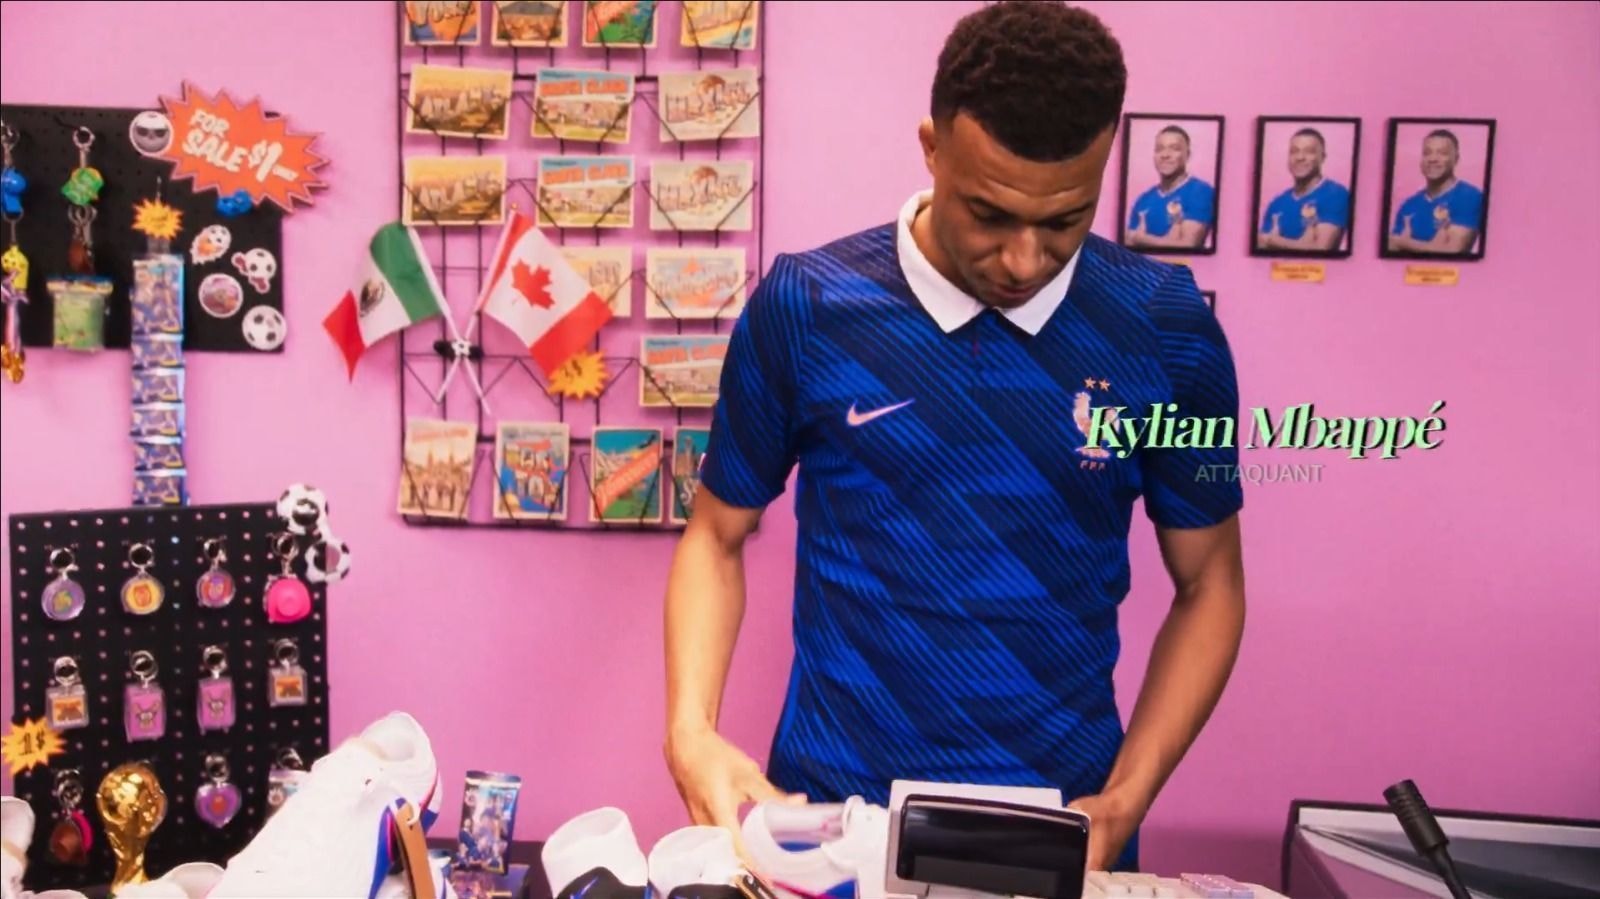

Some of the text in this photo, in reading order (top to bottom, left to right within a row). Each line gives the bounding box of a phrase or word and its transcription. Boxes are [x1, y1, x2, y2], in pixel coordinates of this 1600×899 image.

[190, 109, 230, 138] FOR
[182, 128, 247, 173] SALE
[248, 139, 283, 183] $1
